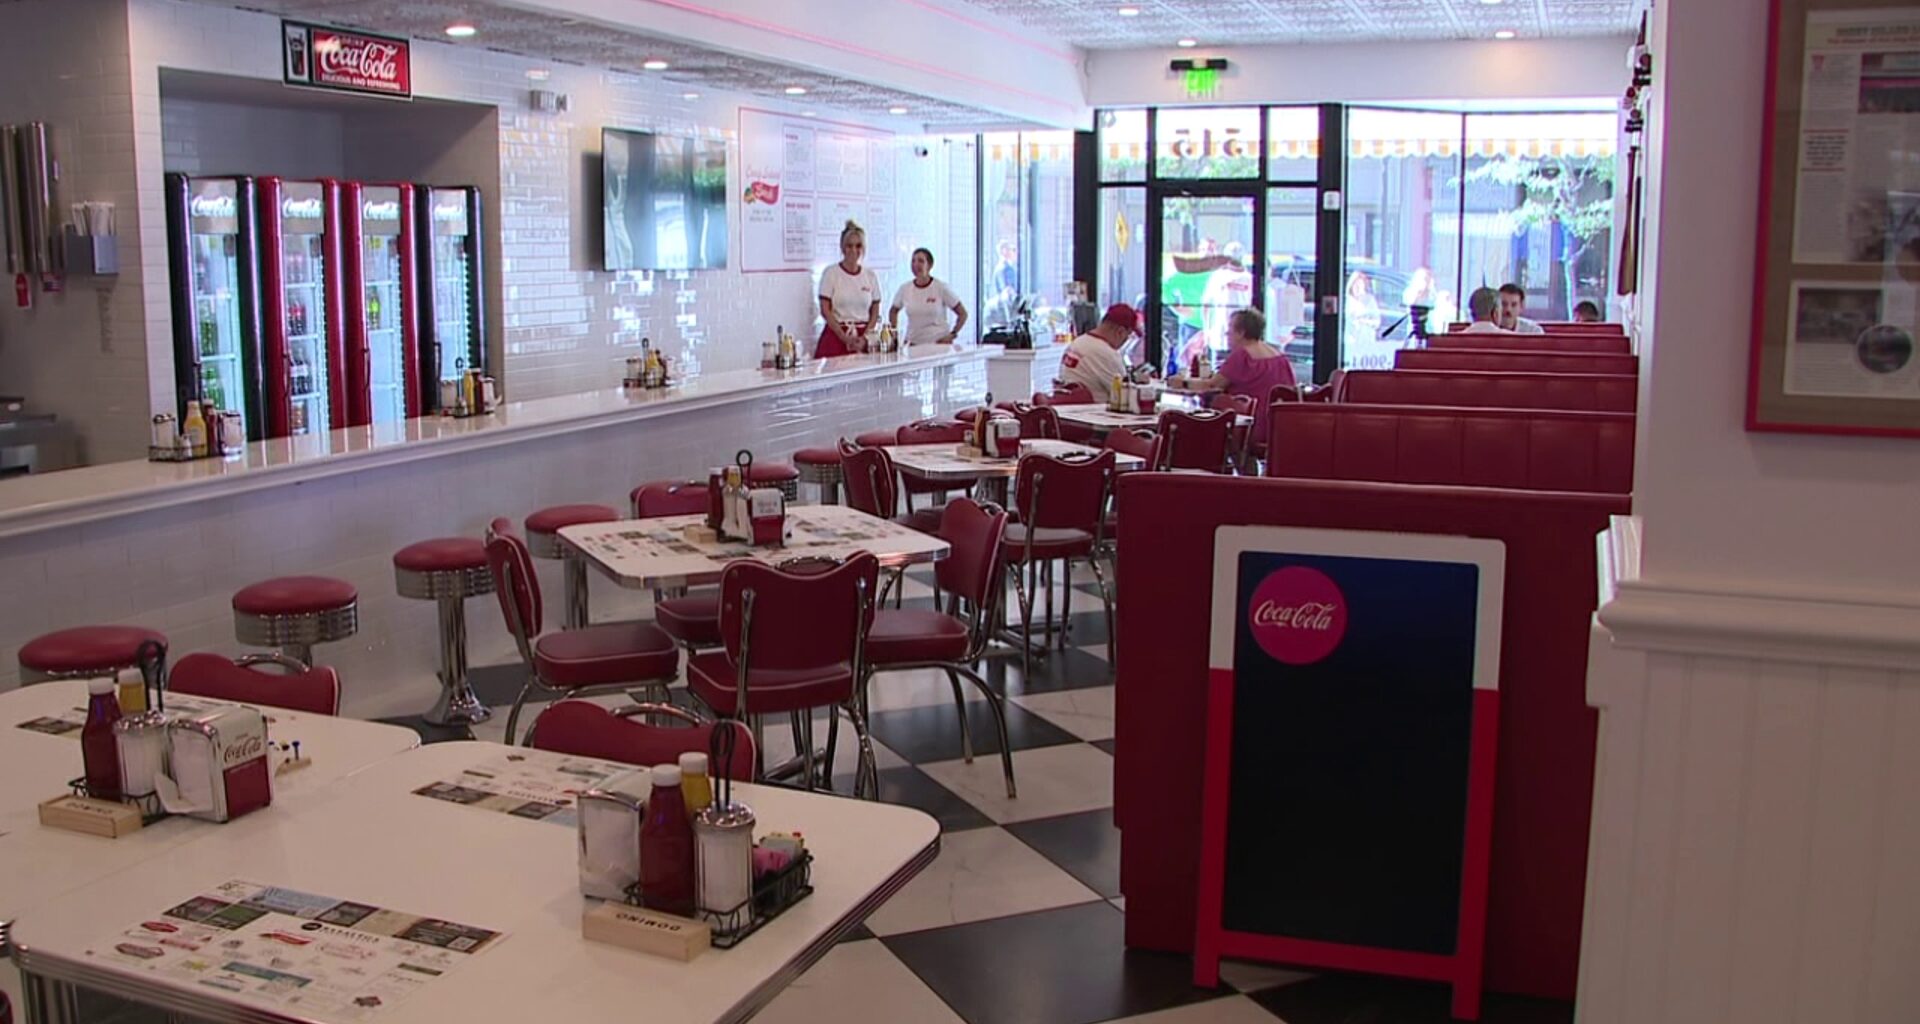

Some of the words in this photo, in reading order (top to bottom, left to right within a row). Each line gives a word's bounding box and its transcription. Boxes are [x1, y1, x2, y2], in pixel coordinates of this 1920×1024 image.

[321, 36, 398, 80] Coca-Cola
[1254, 599, 1337, 630] Coca-Cola
[615, 913, 682, 932] DOMINO
